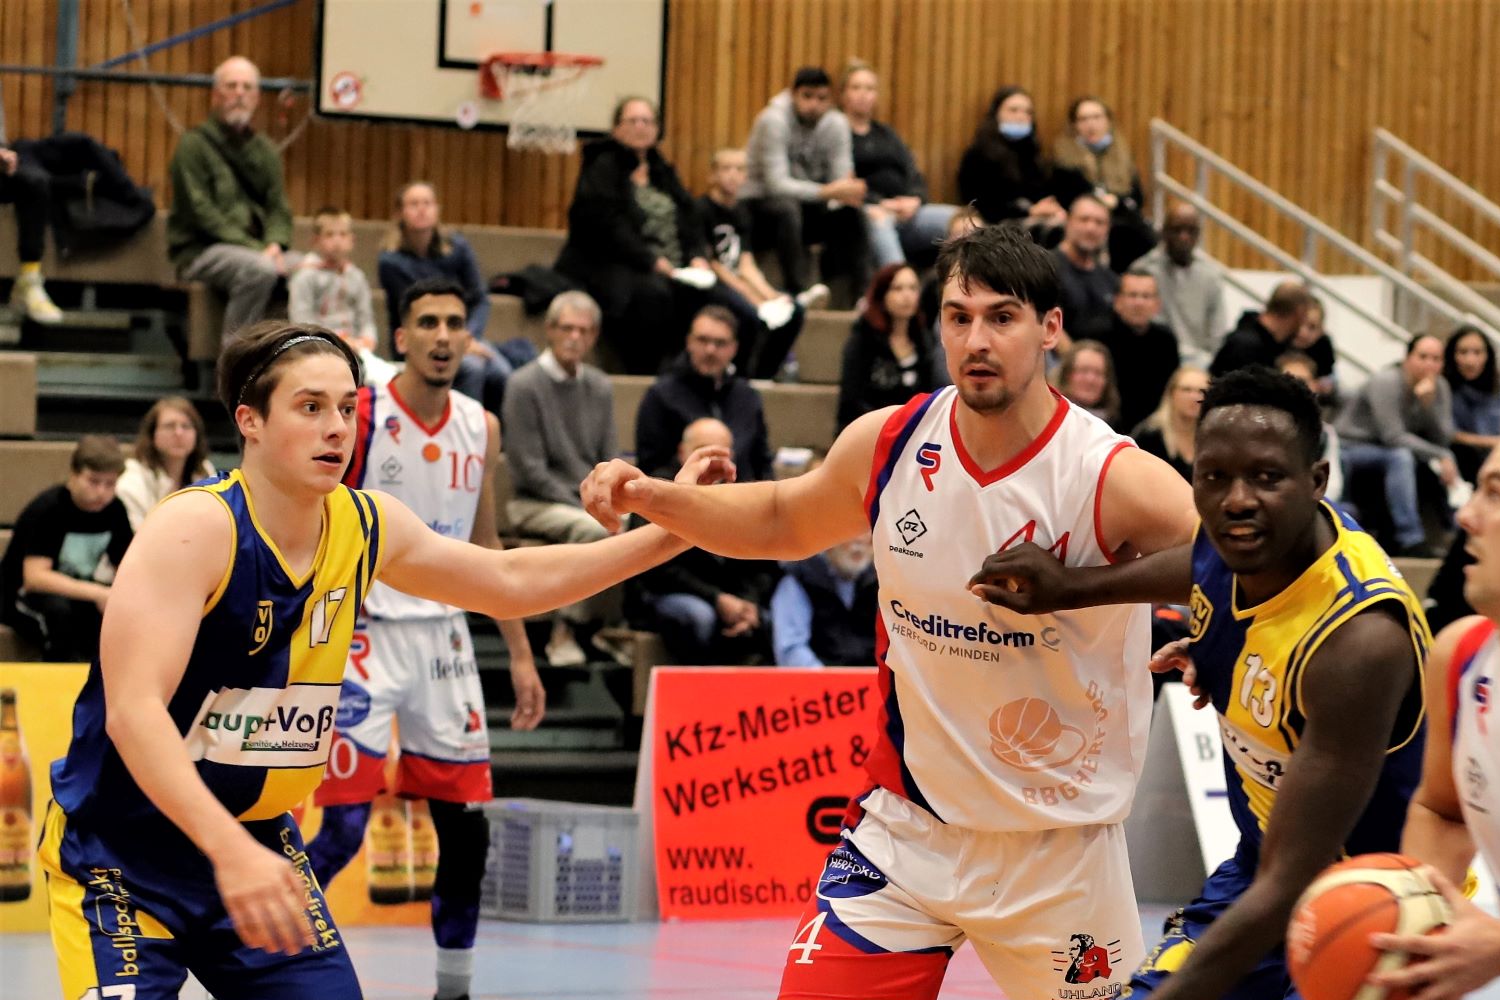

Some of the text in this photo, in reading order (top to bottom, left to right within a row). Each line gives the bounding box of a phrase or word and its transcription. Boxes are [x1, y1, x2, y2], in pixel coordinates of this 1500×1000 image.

[889, 545, 924, 558] peakzone
[310, 587, 348, 649] 17
[890, 600, 1036, 648] Creditreform
[949, 647, 1000, 663] MINDEN
[1239, 654, 1277, 729] 13
[200, 705, 334, 740] aup+Voß
[665, 687, 870, 762] Kfz-Meister
[323, 737, 358, 780] 0
[663, 735, 871, 818] Werkstatt &
[667, 847, 753, 870] www.
[669, 876, 812, 906] raudisch.d
